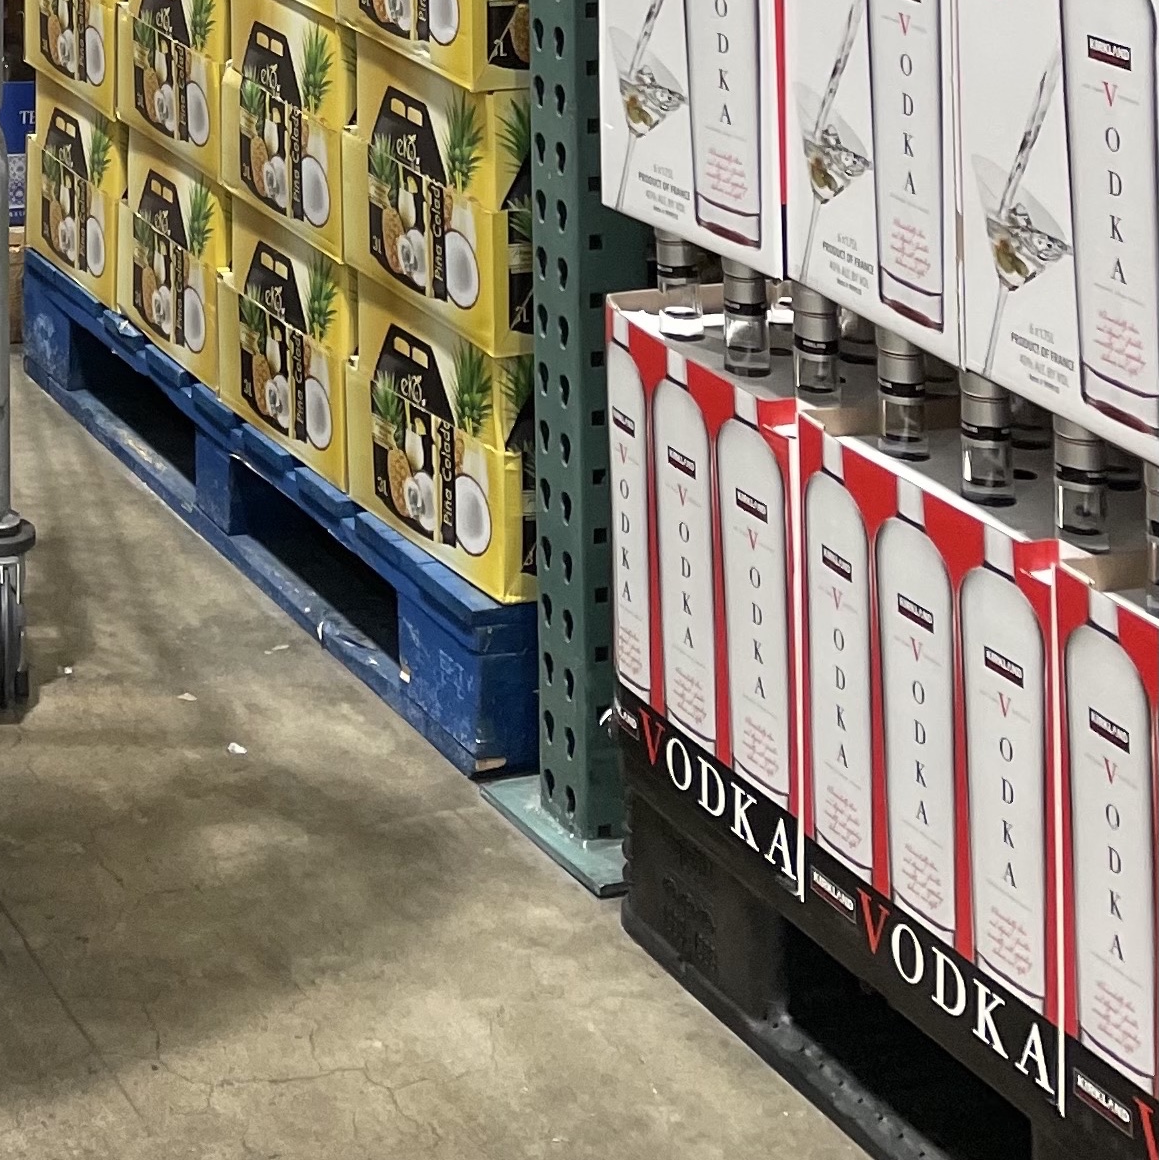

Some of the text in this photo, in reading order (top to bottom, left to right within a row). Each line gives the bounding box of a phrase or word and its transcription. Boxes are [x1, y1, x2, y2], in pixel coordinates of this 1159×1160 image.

[292, 169, 301, 203] Pina
[434, 244, 444, 282] Pina
[442, 488, 453, 527] Pina
[639, 708, 797, 881] VODKA
[855, 887, 1055, 1096] VODKA
